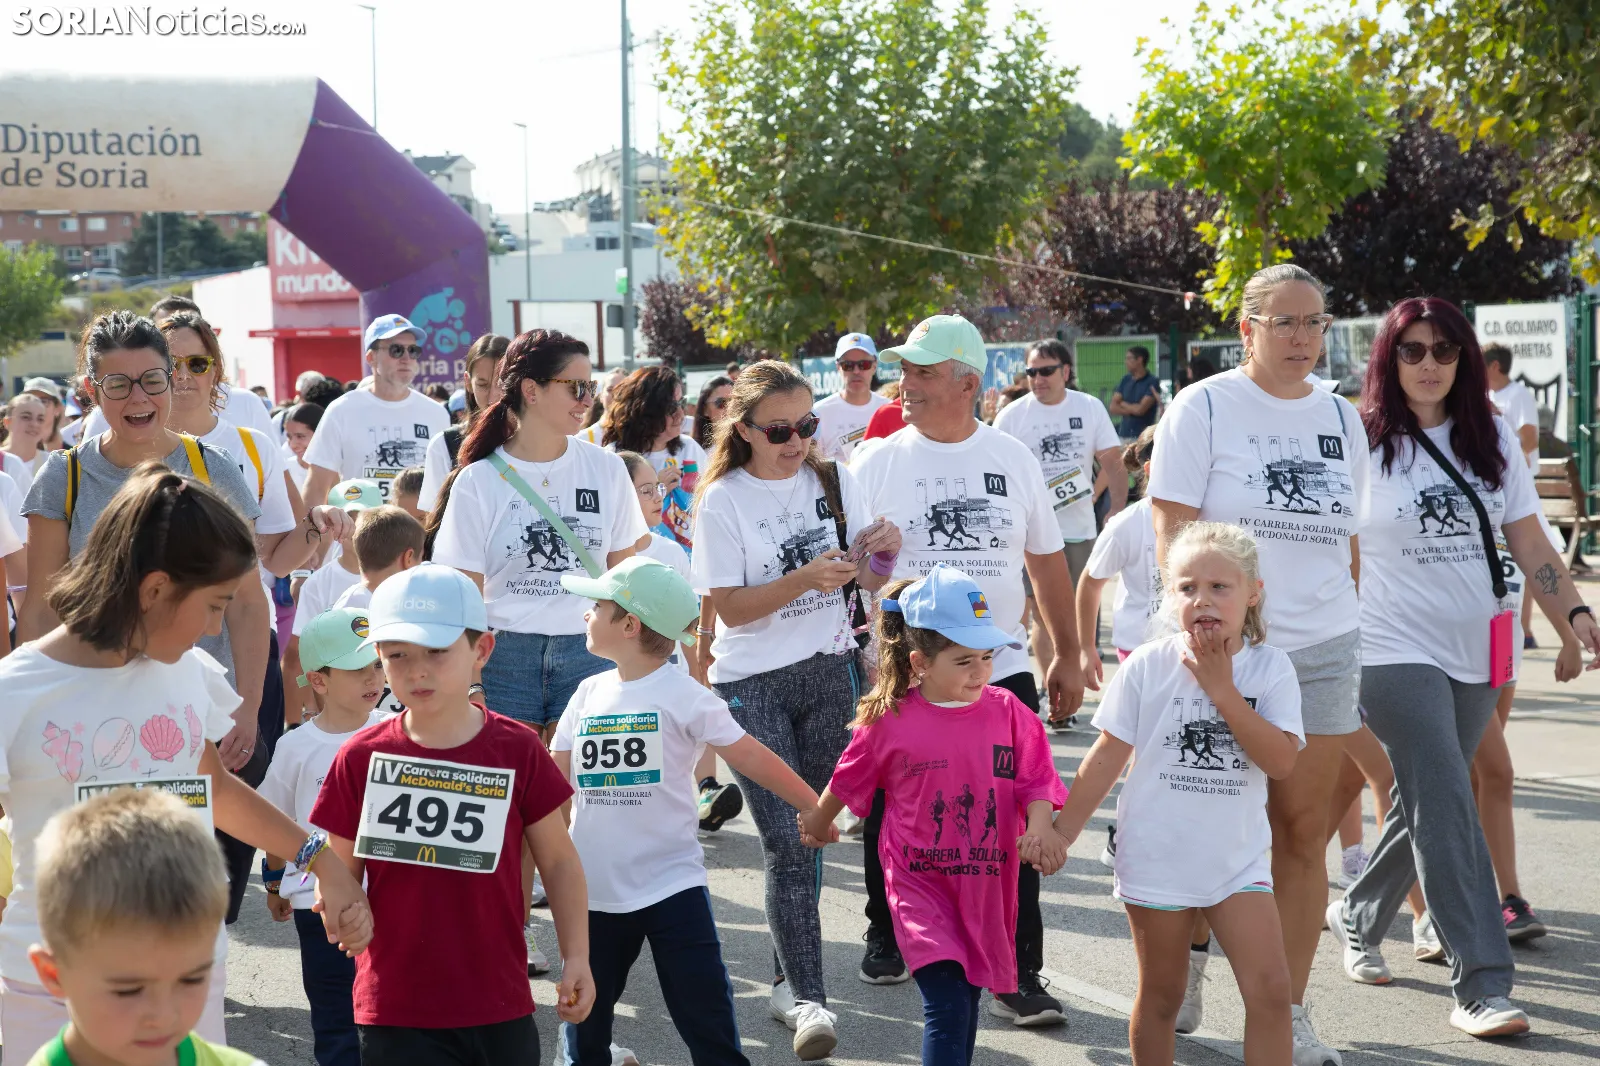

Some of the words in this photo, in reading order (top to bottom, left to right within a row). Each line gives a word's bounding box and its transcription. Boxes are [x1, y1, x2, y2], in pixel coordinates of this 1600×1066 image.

[0, 123, 202, 164] Diputación
[1, 158, 43, 187] de
[56, 161, 149, 188] Soria
[1505, 320, 1557, 335] GOLMAYO
[365, 468, 376, 478] IV
[1054, 481, 1077, 499] 63
[1239, 518, 1251, 526] IV
[1254, 519, 1300, 531] CARRERA
[1302, 524, 1350, 538] SOLIDARIA
[1253, 530, 1308, 542] MCDONALD
[1310, 535, 1338, 546] SORIA
[1402, 548, 1413, 556] IV
[1414, 545, 1459, 555] CARRERA
[966, 560, 1008, 568] SOLIDARIA
[1417, 554, 1469, 565] MCDONALD
[578, 718, 589, 735] IV
[590, 718, 615, 726] Carrera
[616, 714, 656, 724] solidaria
[588, 723, 631, 733] McDonald's
[581, 737, 647, 770] 958
[373, 759, 403, 783] IV
[402, 763, 449, 779] Carrera
[451, 771, 506, 786] solidaria
[1159, 772, 1168, 780] IV
[1170, 774, 1208, 784] CARRERA
[1209, 778, 1249, 787] SOLIDARIA
[400, 774, 472, 793] McDonald's
[474, 784, 505, 797] Soria
[1170, 783, 1216, 794] MCDONALD
[1217, 788, 1241, 796] SORIA
[612, 790, 652, 798] SOLIDARIA
[377, 793, 486, 843] 495
